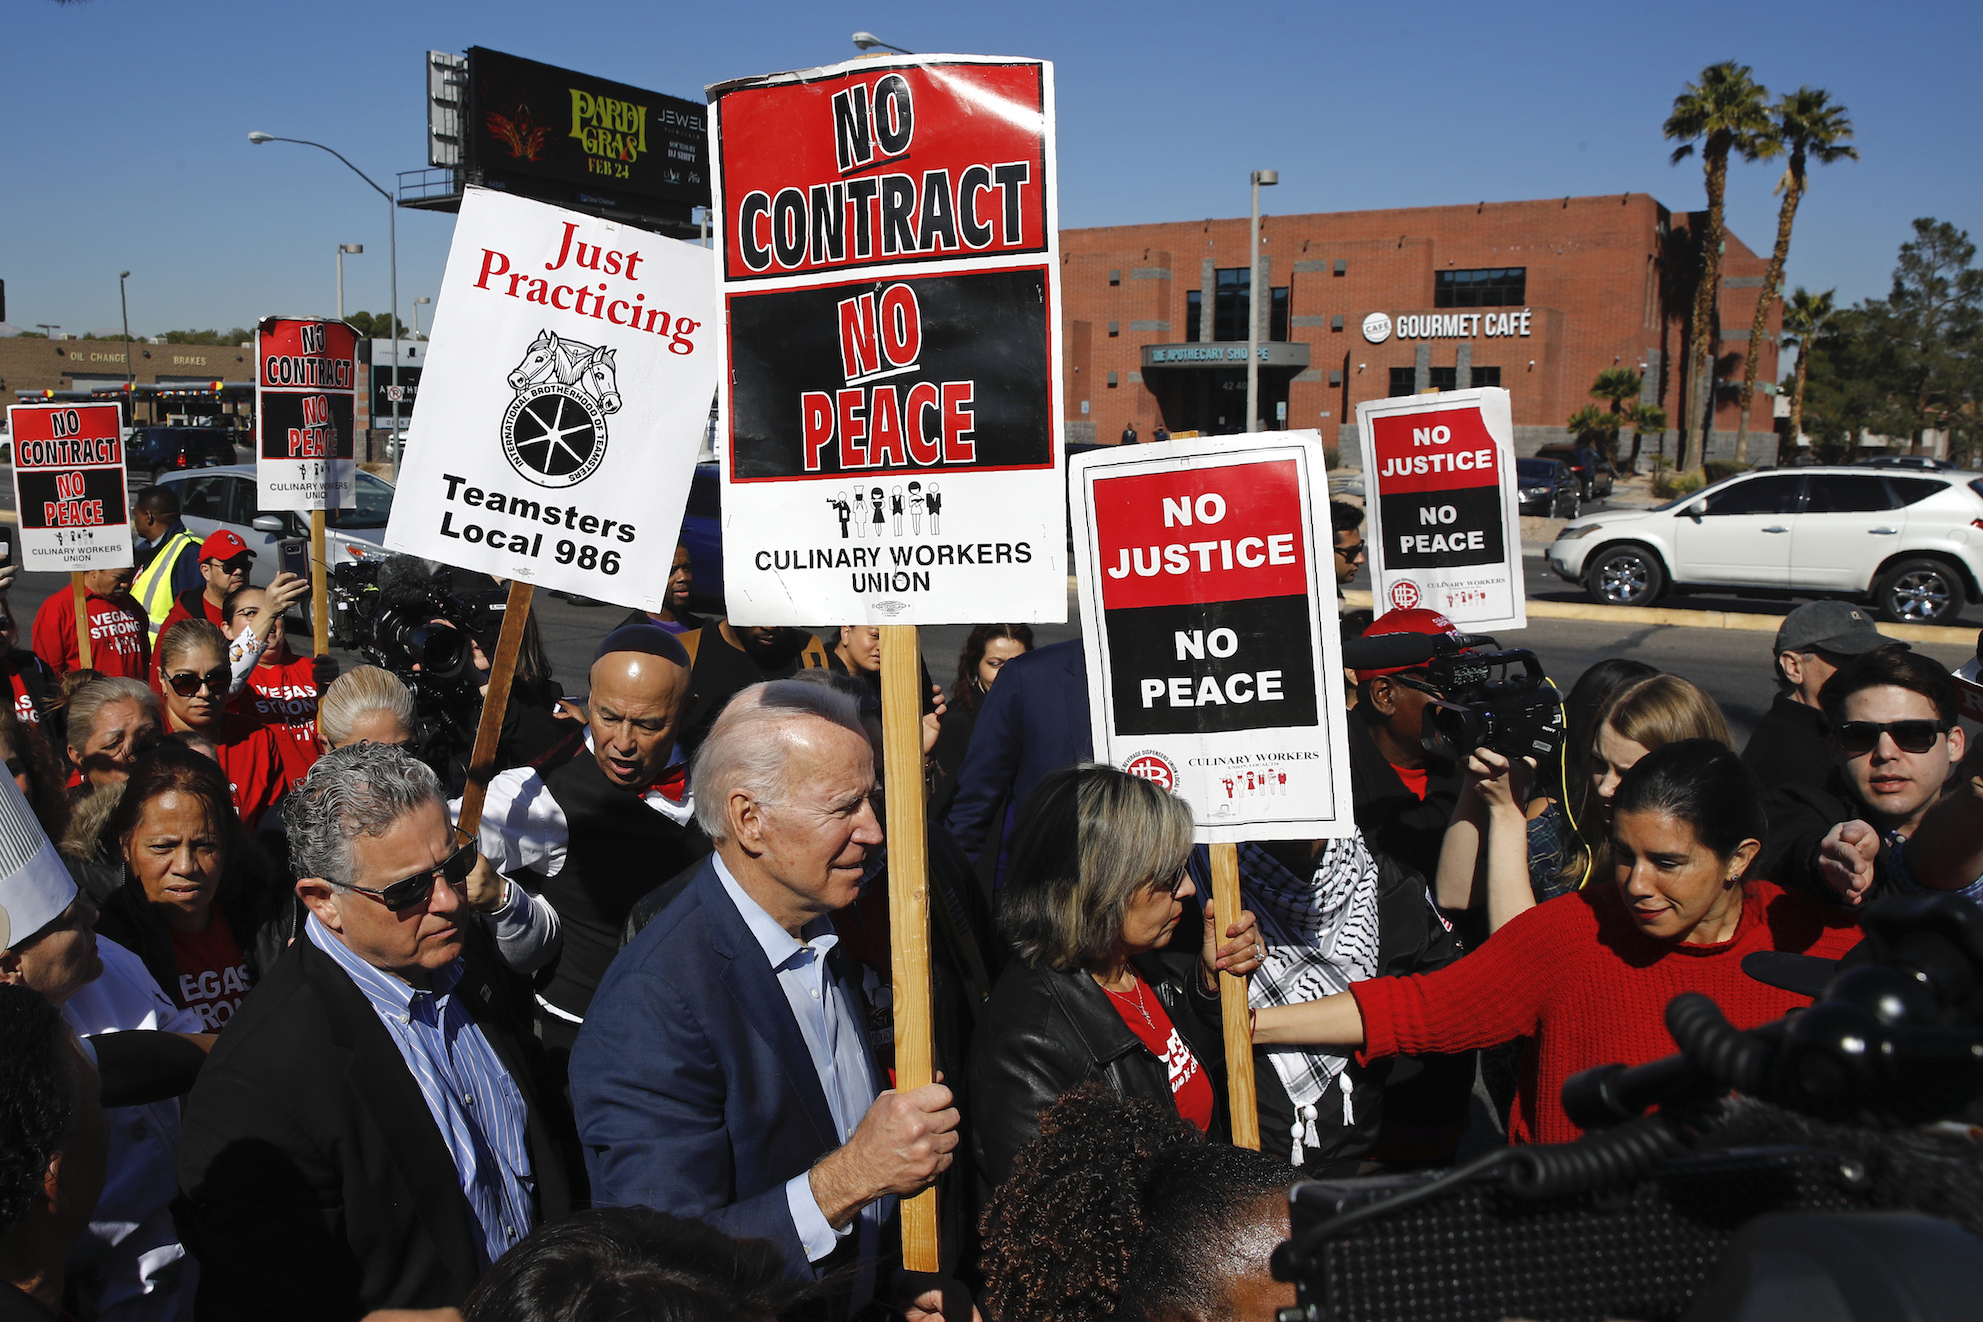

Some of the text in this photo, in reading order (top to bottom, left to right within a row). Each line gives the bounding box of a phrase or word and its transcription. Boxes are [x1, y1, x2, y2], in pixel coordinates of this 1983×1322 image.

[568, 88, 648, 152] PARDI
[658, 110, 706, 132] JEWEL
[832, 72, 914, 173] NO
[582, 126, 637, 162] GRAS
[588, 158, 629, 178] FEB 24
[739, 160, 1030, 272] CONTRACT
[545, 221, 644, 280] Just
[473, 248, 702, 355] Practicing
[838, 282, 922, 380] NO
[1396, 308, 1532, 338] GOURMET CAFÉ
[301, 323, 326, 355] NO
[70, 352, 126, 362] OIL CHANGE
[174, 356, 206, 366] BRAKES
[1168, 348, 1224, 361] APOTHECARY
[266, 355, 352, 387] CONTRACT
[51, 409, 80, 438] NO
[303, 395, 328, 425] NO
[504, 385, 604, 482] INTERNATIONAL BROTHERHOOD OF TEAMSTERS
[802, 380, 976, 471] PEACE
[1413, 425, 1452, 446] NO
[20, 437, 117, 466] CONTRACT
[288, 428, 337, 457] PEACE
[1381, 449, 1492, 477] JUSTICE
[56, 472, 85, 500] NO
[270, 482, 318, 491] CULINARY
[44, 500, 104, 526] PEACE
[443, 474, 636, 542] Teamsters
[1162, 492, 1226, 528] NO
[1420, 505, 1458, 526] NO
[32, 545, 122, 556] CULINARY WORKERS
[440, 512, 622, 576] Local 986
[755, 542, 1032, 570] CULINARY WORKERS
[1108, 533, 1296, 580] JUSTICE
[1400, 531, 1486, 554] PEACE
[852, 571, 930, 593] UNION
[90, 610, 135, 626] VEGAS
[90, 620, 140, 640] STRONG
[1174, 628, 1239, 661] NO
[256, 685, 318, 700] VEGAS
[1140, 670, 1285, 708] PEACE
[1189, 751, 1320, 768] CULINARY WORKERS
